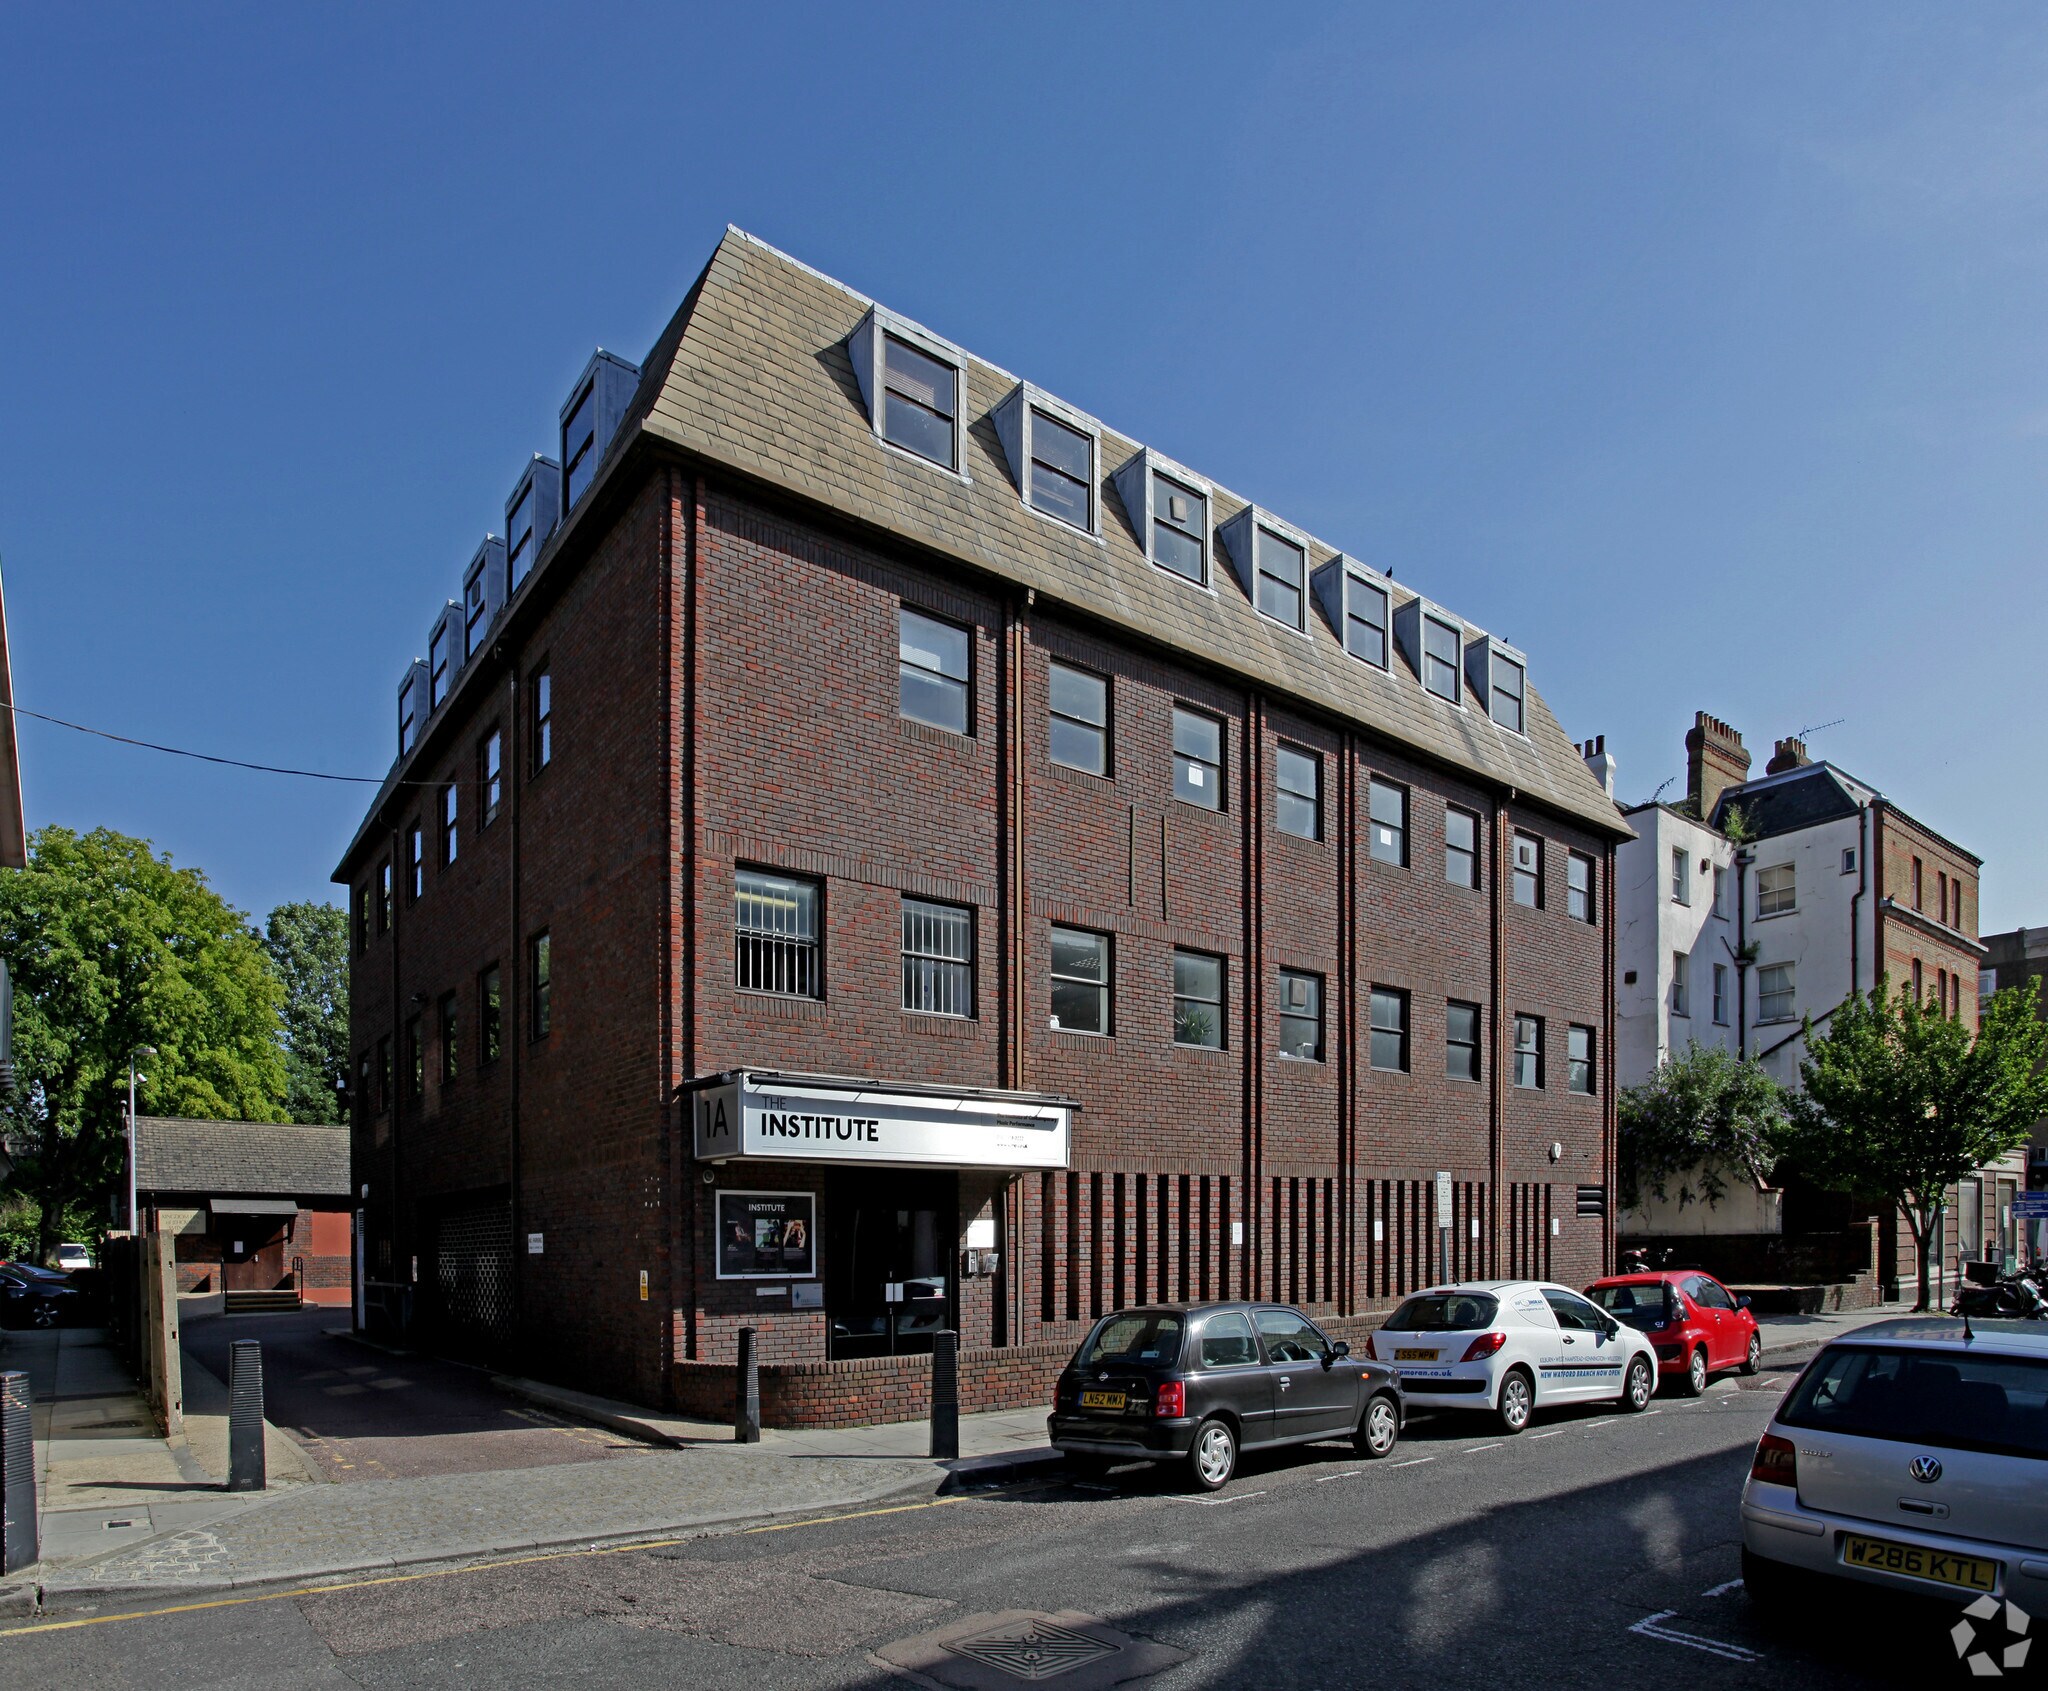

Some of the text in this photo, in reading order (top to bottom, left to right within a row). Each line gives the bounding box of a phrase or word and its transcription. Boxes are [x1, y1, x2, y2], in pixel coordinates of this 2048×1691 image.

[762, 1095, 787, 1110] THE
[704, 1098, 729, 1138] 1A
[761, 1113, 879, 1142] INSTITUTE
[748, 1203, 786, 1212] INSTITUTE
[1083, 1392, 1106, 1405] LN52
[1801, 1448, 1833, 1459] GOLF
[1852, 1540, 1989, 1587] W286 KTL
